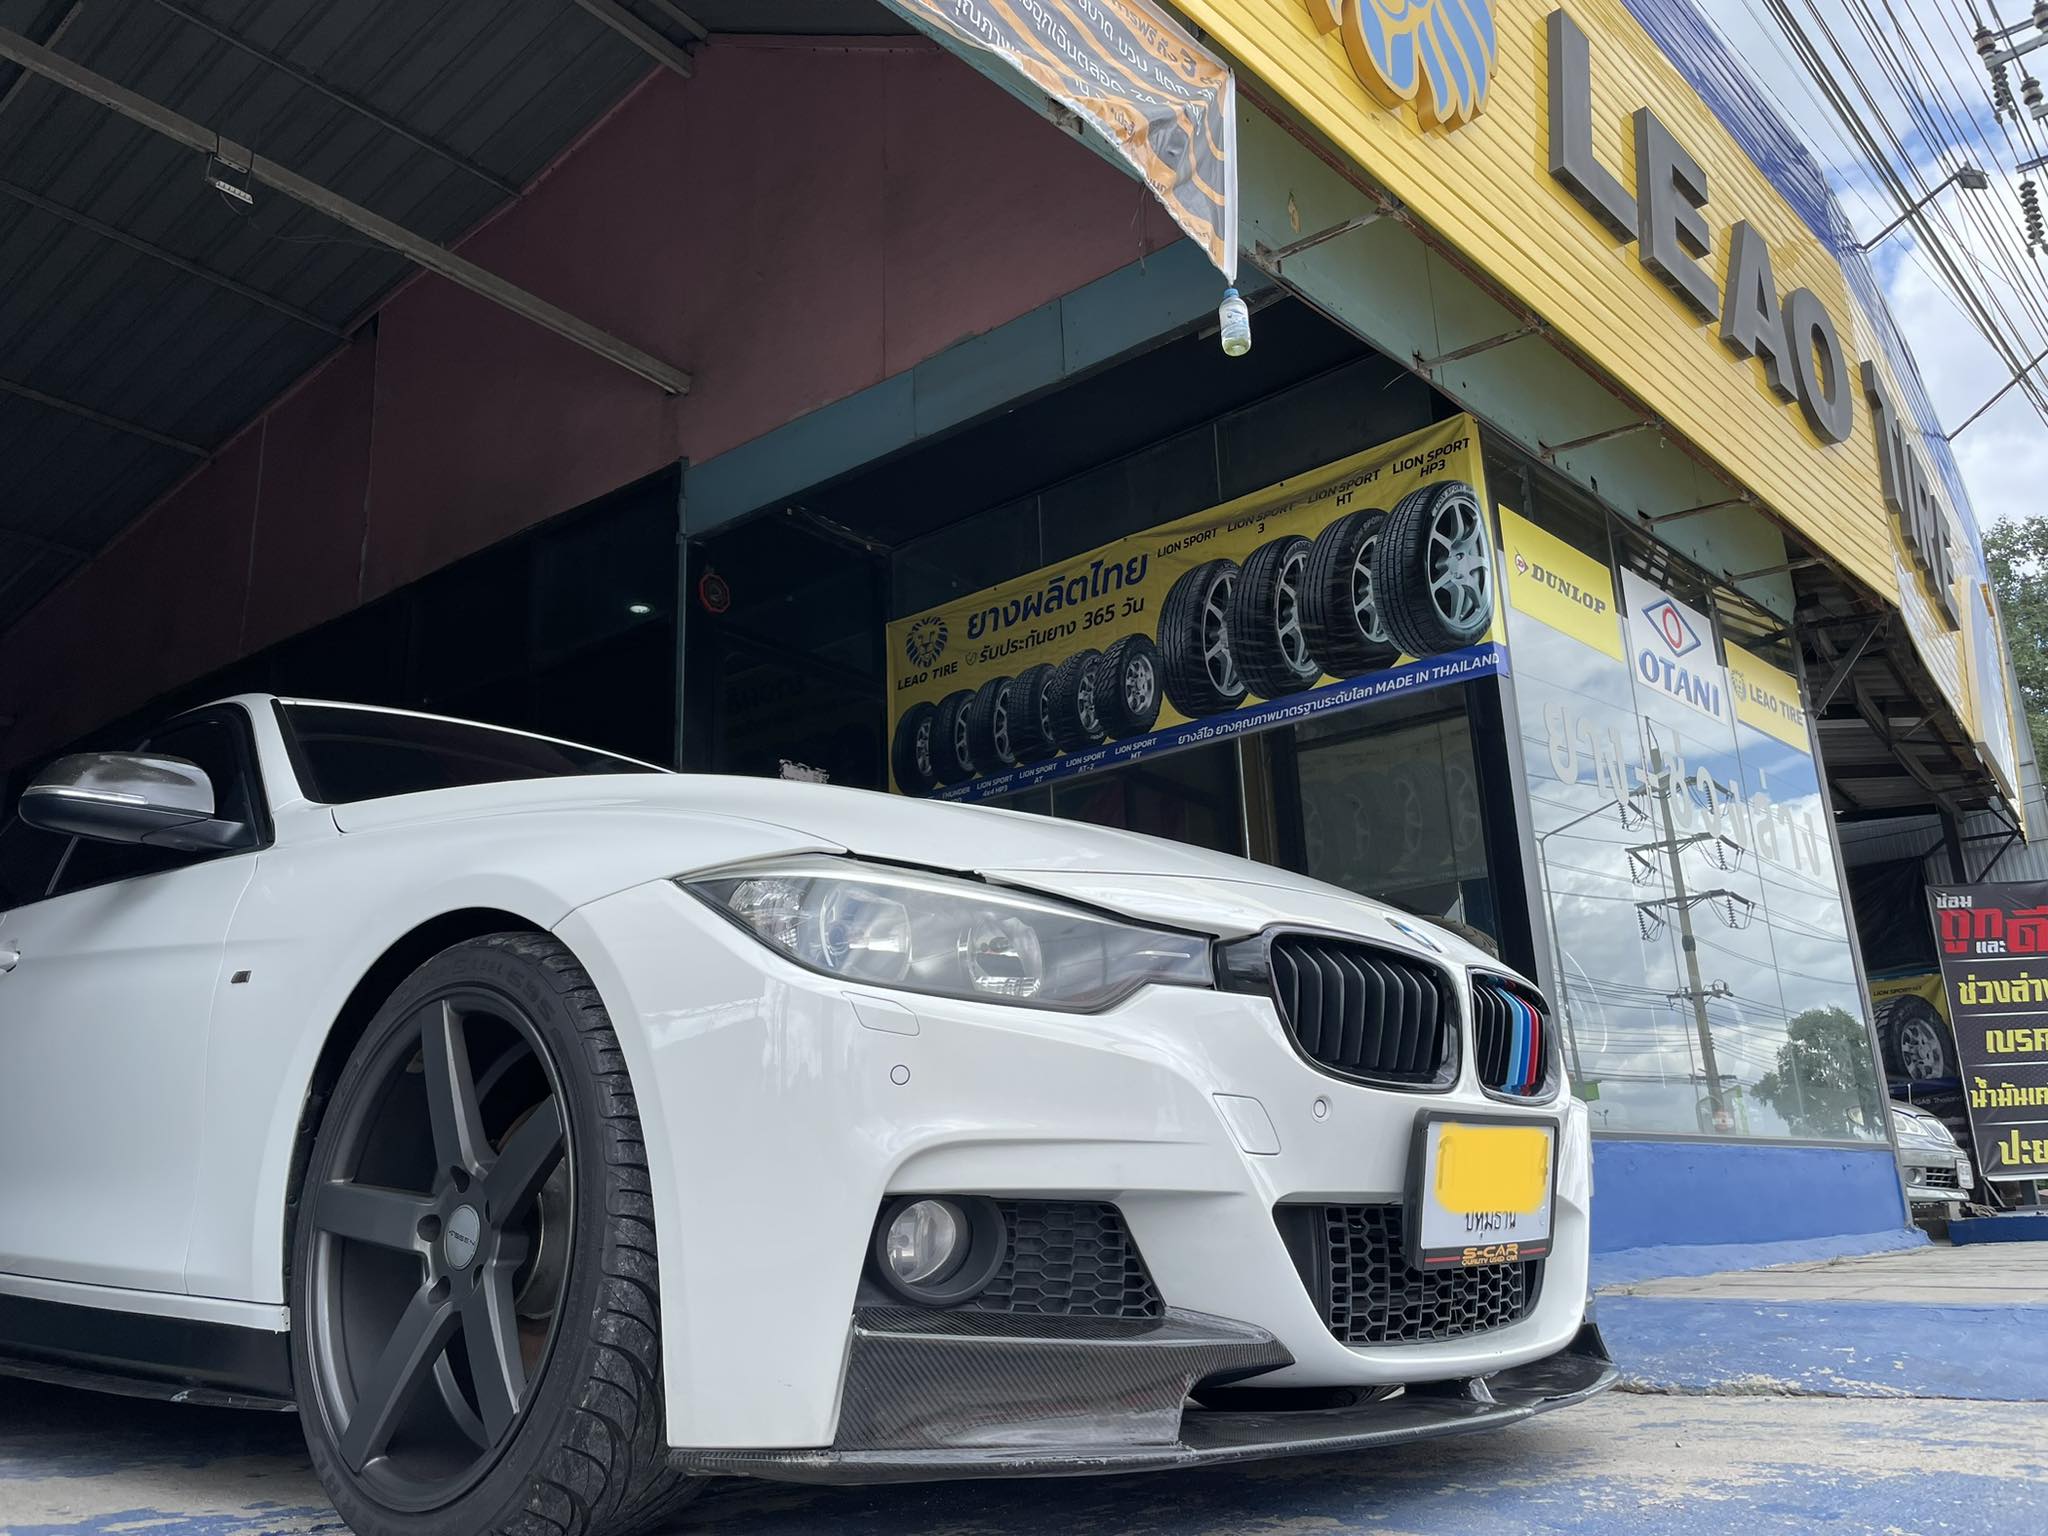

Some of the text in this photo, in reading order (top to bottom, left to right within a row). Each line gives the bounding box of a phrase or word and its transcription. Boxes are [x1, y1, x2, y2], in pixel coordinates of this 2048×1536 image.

[1180, 48, 1197, 77] 3
[1547, 8, 1853, 446] LEAO
[1391, 437, 1471, 475] LION SPORT
[1419, 459, 1446, 478] HP3
[1307, 468, 1381, 505] LION SPORT
[1336, 491, 1353, 507] HT
[1226, 502, 1297, 533] LION SPORT
[1257, 522, 1265, 535] 3
[1157, 528, 1218, 558] LION SPORT
[967, 553, 1148, 640] ยางผลิตไทย
[1531, 563, 1606, 615] DUNLOP
[979, 597, 1145, 664] รับประกันยาง 365 วัน
[897, 660, 958, 690] LEAO TIRE
[1638, 648, 1720, 717] OTANI
[1215, 685, 1373, 734] ยางคุณภาพมาตรฐานระดับโลก
[1375, 676, 1413, 696] MADE
[1415, 671, 1430, 685] IN
[1432, 652, 1501, 679] THAILAND
[1749, 682, 1804, 728] LEAO TIRE
[1065, 751, 1106, 768] LION SPORT
[1115, 737, 1157, 756] LION SPORT
[1130, 750, 1142, 760] MT
[976, 774, 1014, 791] LION SPORT
[1019, 762, 1057, 780] LION SPORT
[1034, 775, 1043, 784] AT
[1078, 763, 1095, 773] AT-2
[1976, 940, 2006, 954] และ
[1463, 1243, 1519, 1259] S-CAR
